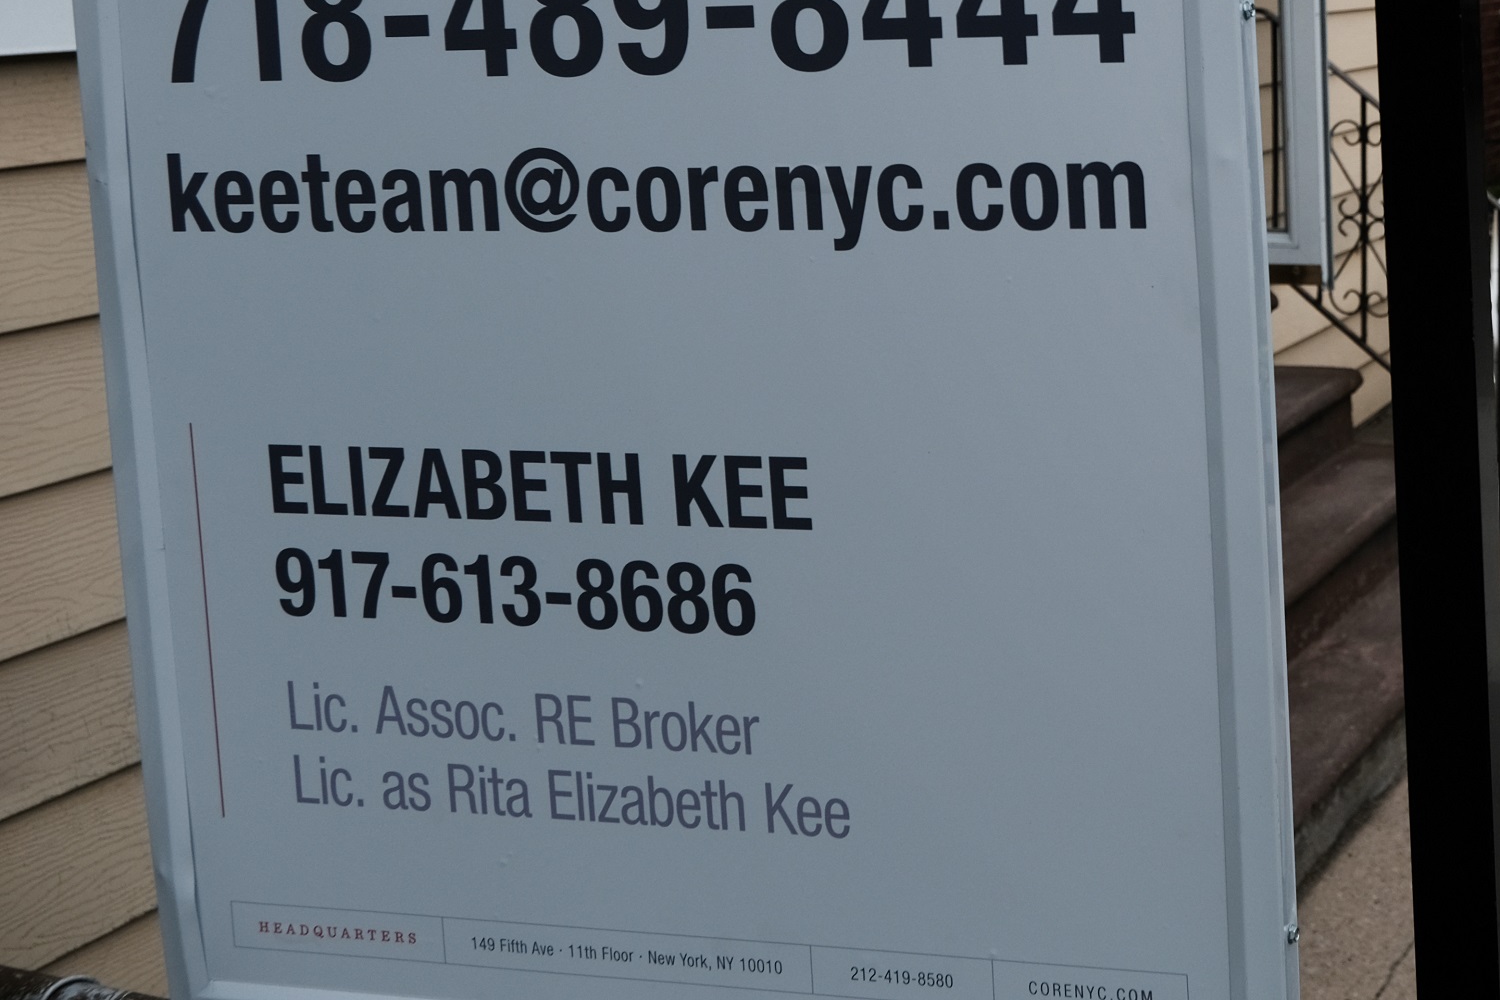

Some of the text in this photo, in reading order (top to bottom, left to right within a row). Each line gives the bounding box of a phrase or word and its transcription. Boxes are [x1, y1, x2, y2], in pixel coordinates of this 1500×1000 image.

[166, 147, 1147, 251] keeteam@corenyc.com
[268, 444, 813, 530] ELIZABETH KEE
[275, 547, 757, 636] 917-613-8686
[287, 681, 760, 755] Lic. Assoc. RE Broker
[293, 754, 851, 839] Lic. as Rita Elizabeth Kee
[257, 920, 418, 945] HEADQUARTERS
[471, 936, 783, 975] 149 Fifth Ave 11th Floor New York, NY 10010
[850, 966, 954, 989] 212-419-8580
[1028, 972, 1154, 1000] CORENYC.COM
